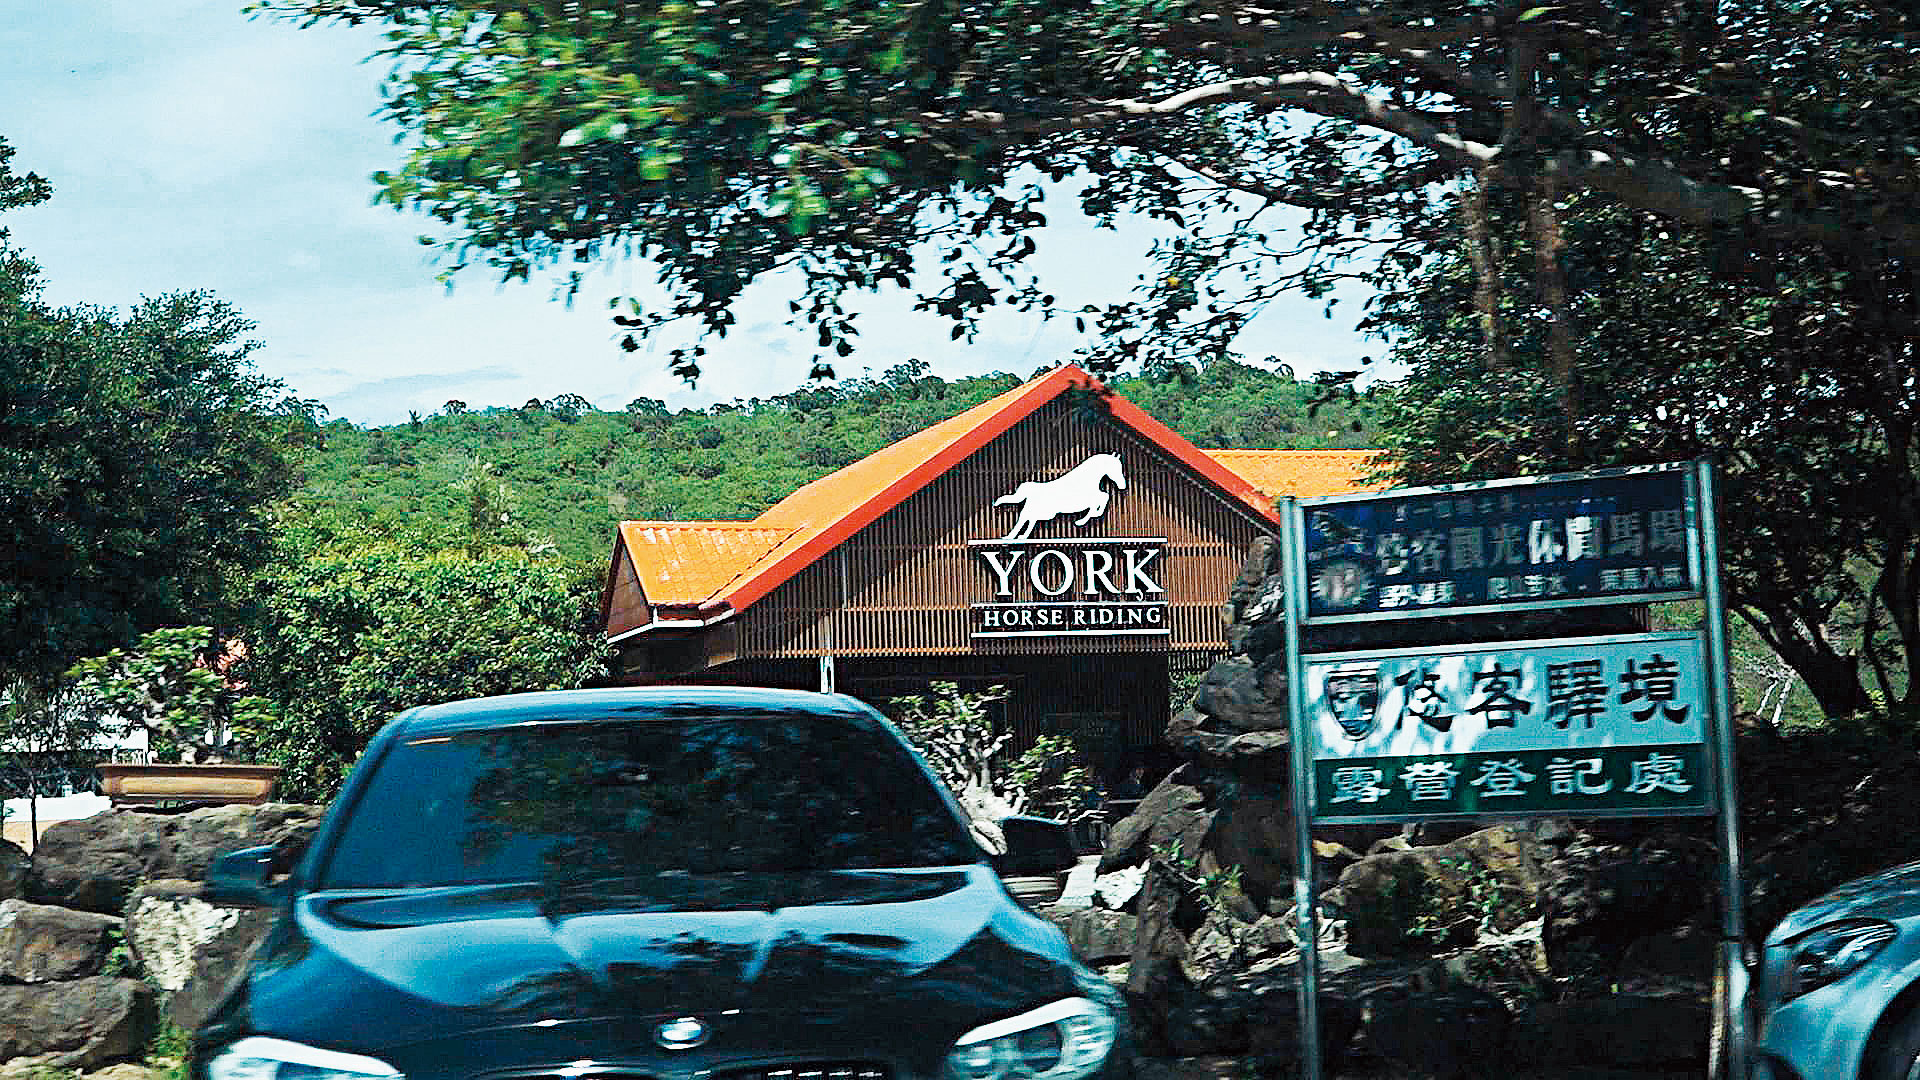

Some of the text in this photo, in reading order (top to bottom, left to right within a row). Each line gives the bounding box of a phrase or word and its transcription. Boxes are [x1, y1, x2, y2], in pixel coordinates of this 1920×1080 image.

[981, 549, 1164, 599] YORK
[984, 607, 1161, 627] HORSE RIDING
[1395, 653, 1691, 733] 悠客驛境
[1329, 751, 1695, 804] 露營登記處
